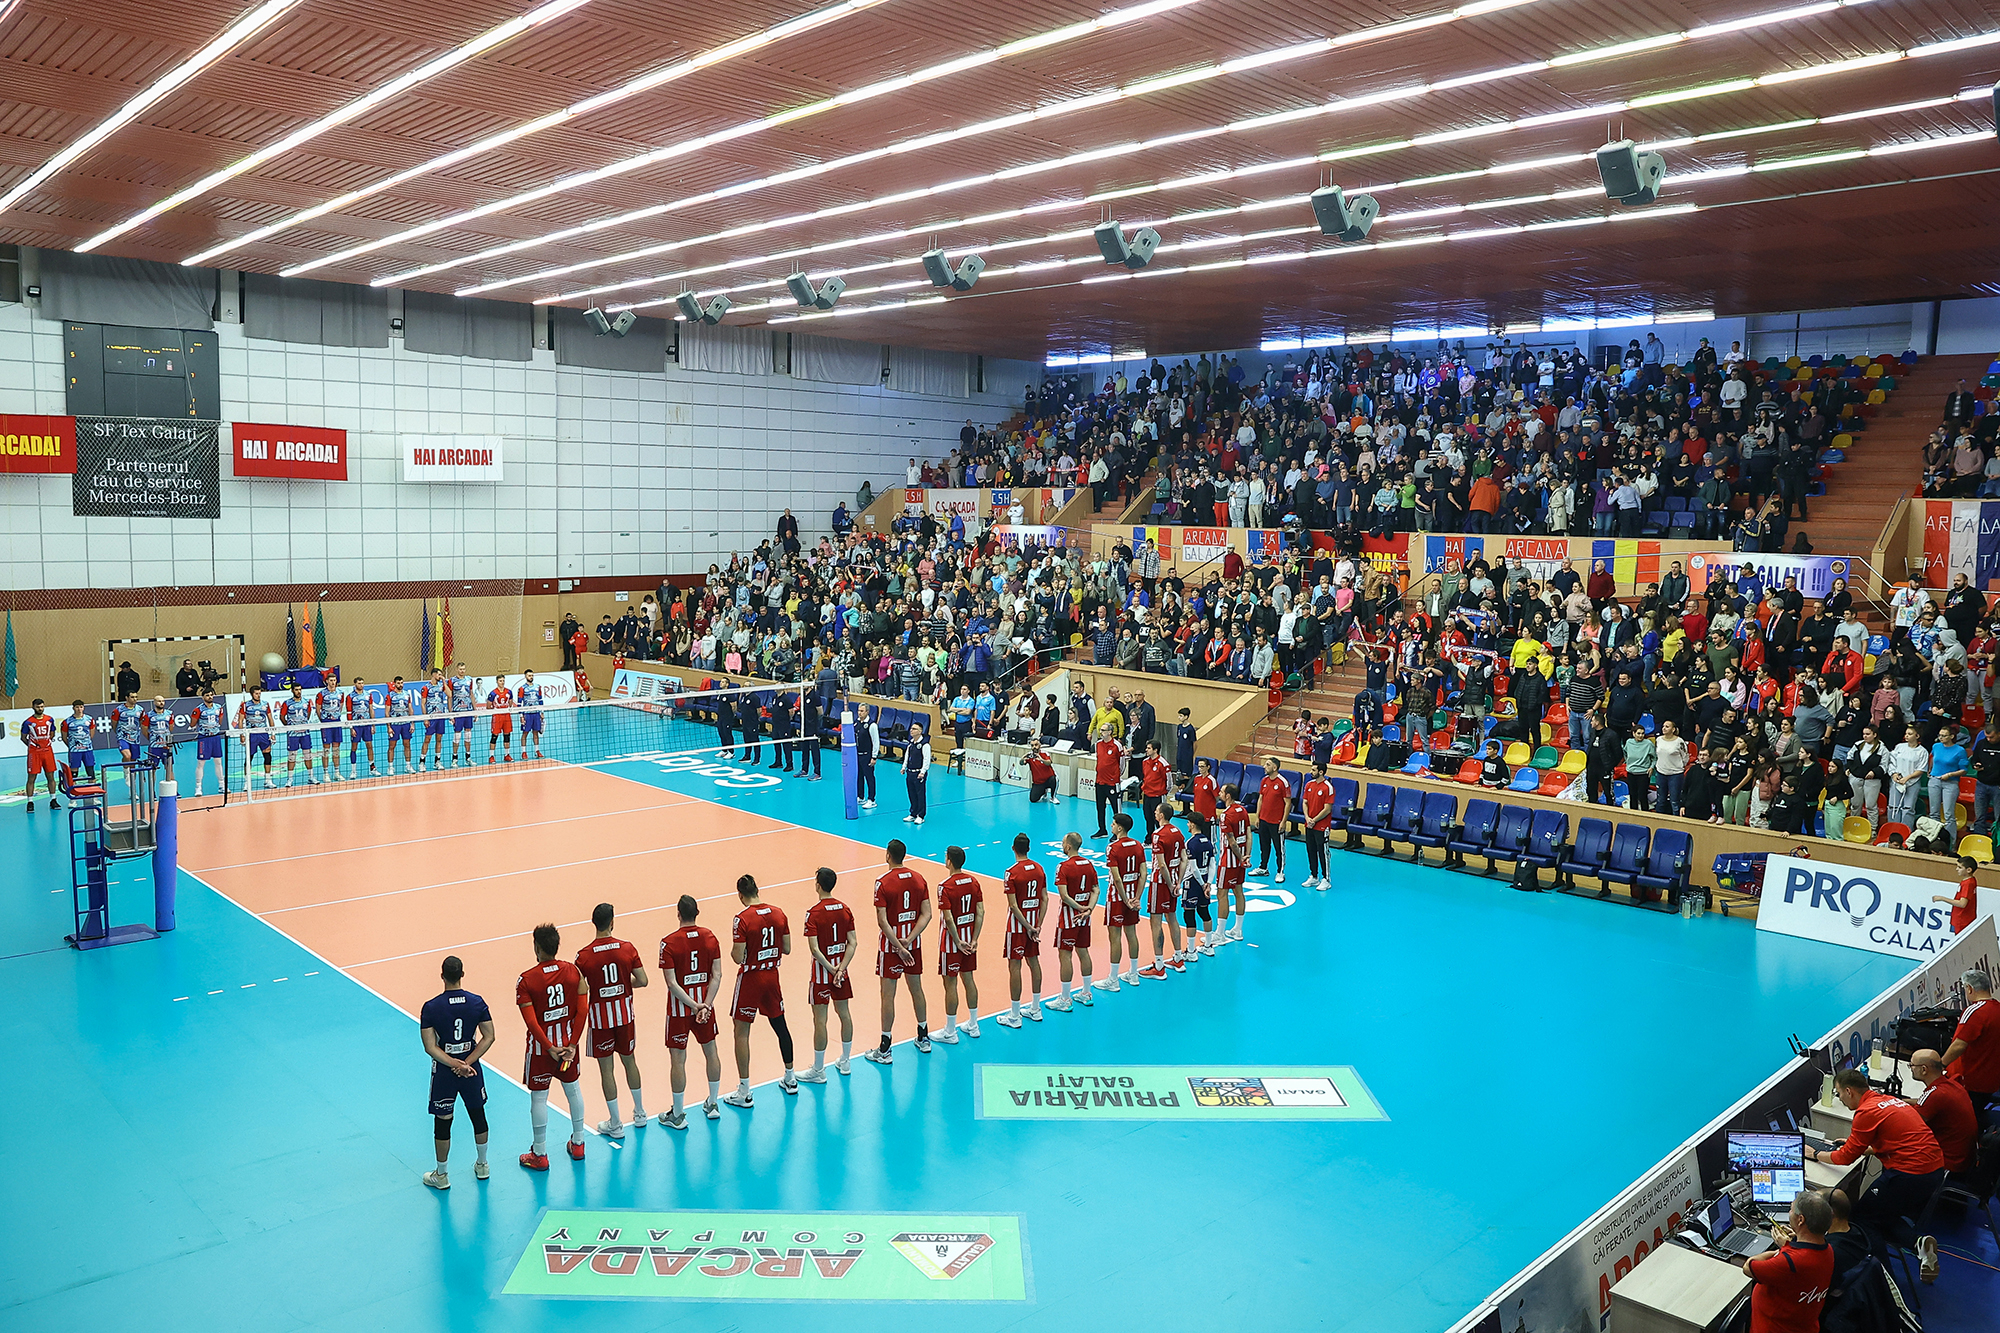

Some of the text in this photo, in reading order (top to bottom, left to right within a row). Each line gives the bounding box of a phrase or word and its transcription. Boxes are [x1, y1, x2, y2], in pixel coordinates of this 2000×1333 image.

[94, 423, 115, 437] SF
[119, 424, 147, 438] Tex
[242, 439, 339, 464] HAI ARCADA!
[413, 448, 493, 466] HAI ARCADA!
[106, 457, 189, 473] Partenerul
[93, 474, 202, 489] tău de service
[89, 489, 207, 505] Mercedes-Benz
[1185, 530, 1226, 546] ARCADA
[1259, 532, 1281, 546] HAI
[1445, 539, 1465, 554] HAI
[1505, 540, 1566, 559] ARCADA
[36, 725, 47, 736] 15
[127, 716, 135, 726] 11
[1174, 841, 1180, 858] 2
[1126, 854, 1136, 873] 11
[1026, 879, 1038, 898] 12
[1080, 874, 1086, 892] 4
[1783, 866, 1882, 919] PRO
[903, 890, 911, 910] 8
[960, 893, 972, 914] 17
[761, 926, 775, 948] 21
[832, 922, 838, 942] 1
[690, 950, 699, 972] 5
[601, 962, 619, 985] 10
[546, 983, 565, 1008] 23
[453, 1018, 464, 1041] 3
[1007, 1089, 1181, 1111] PRIMĂRIA
[1670, 1174, 1693, 1201] PODURI
[544, 1227, 866, 1245] COMPANY
[908, 1234, 969, 1242] ARCADA
[541, 1244, 866, 1280] ARCADA
[949, 1243, 986, 1270] GALATI
